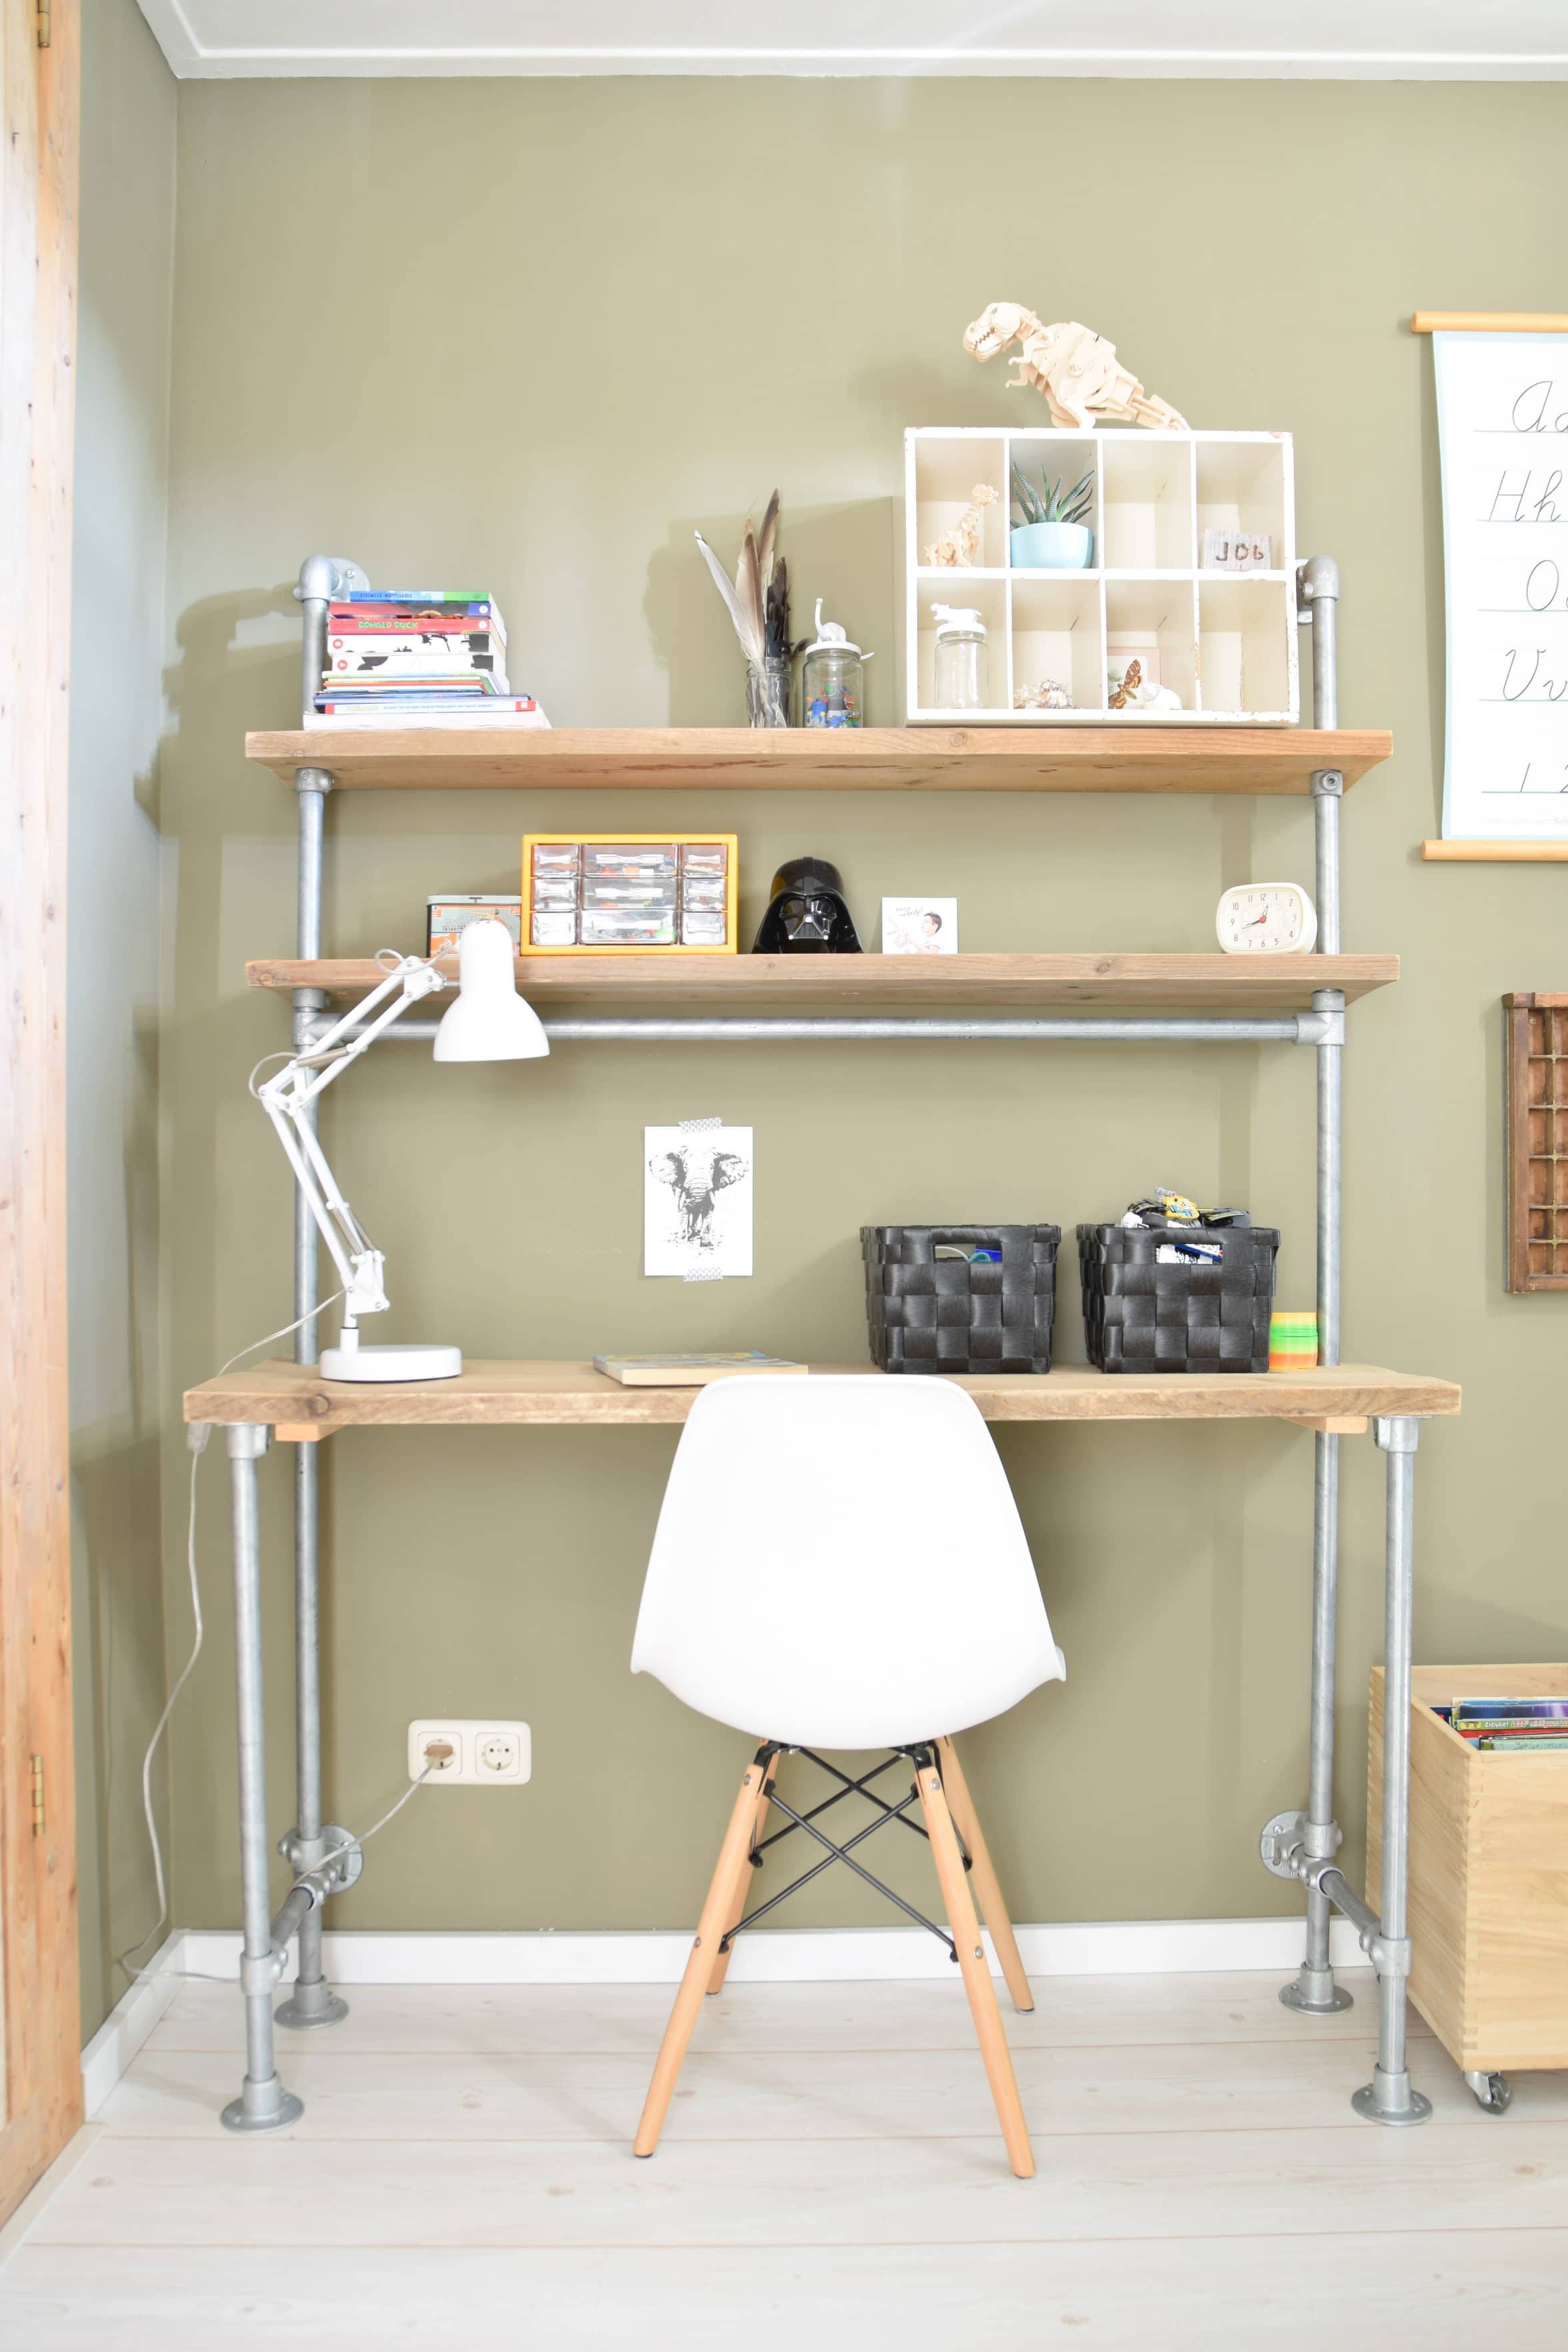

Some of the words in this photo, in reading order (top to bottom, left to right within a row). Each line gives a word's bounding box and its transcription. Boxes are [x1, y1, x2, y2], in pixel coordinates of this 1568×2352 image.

[359, 621, 391, 629] DONALD
[395, 621, 417, 629] DUCK
[1248, 895, 1253, 903] 11
[1260, 893, 1267, 901] 12
[1233, 902, 1239, 911] 10
[1289, 898, 1293, 907] 2
[1230, 918, 1235, 926] 9
[1233, 933, 1238, 941] 8
[1274, 937, 1279, 945] 5
[1248, 939, 1252, 948] 7
[1261, 939, 1265, 947] 6
